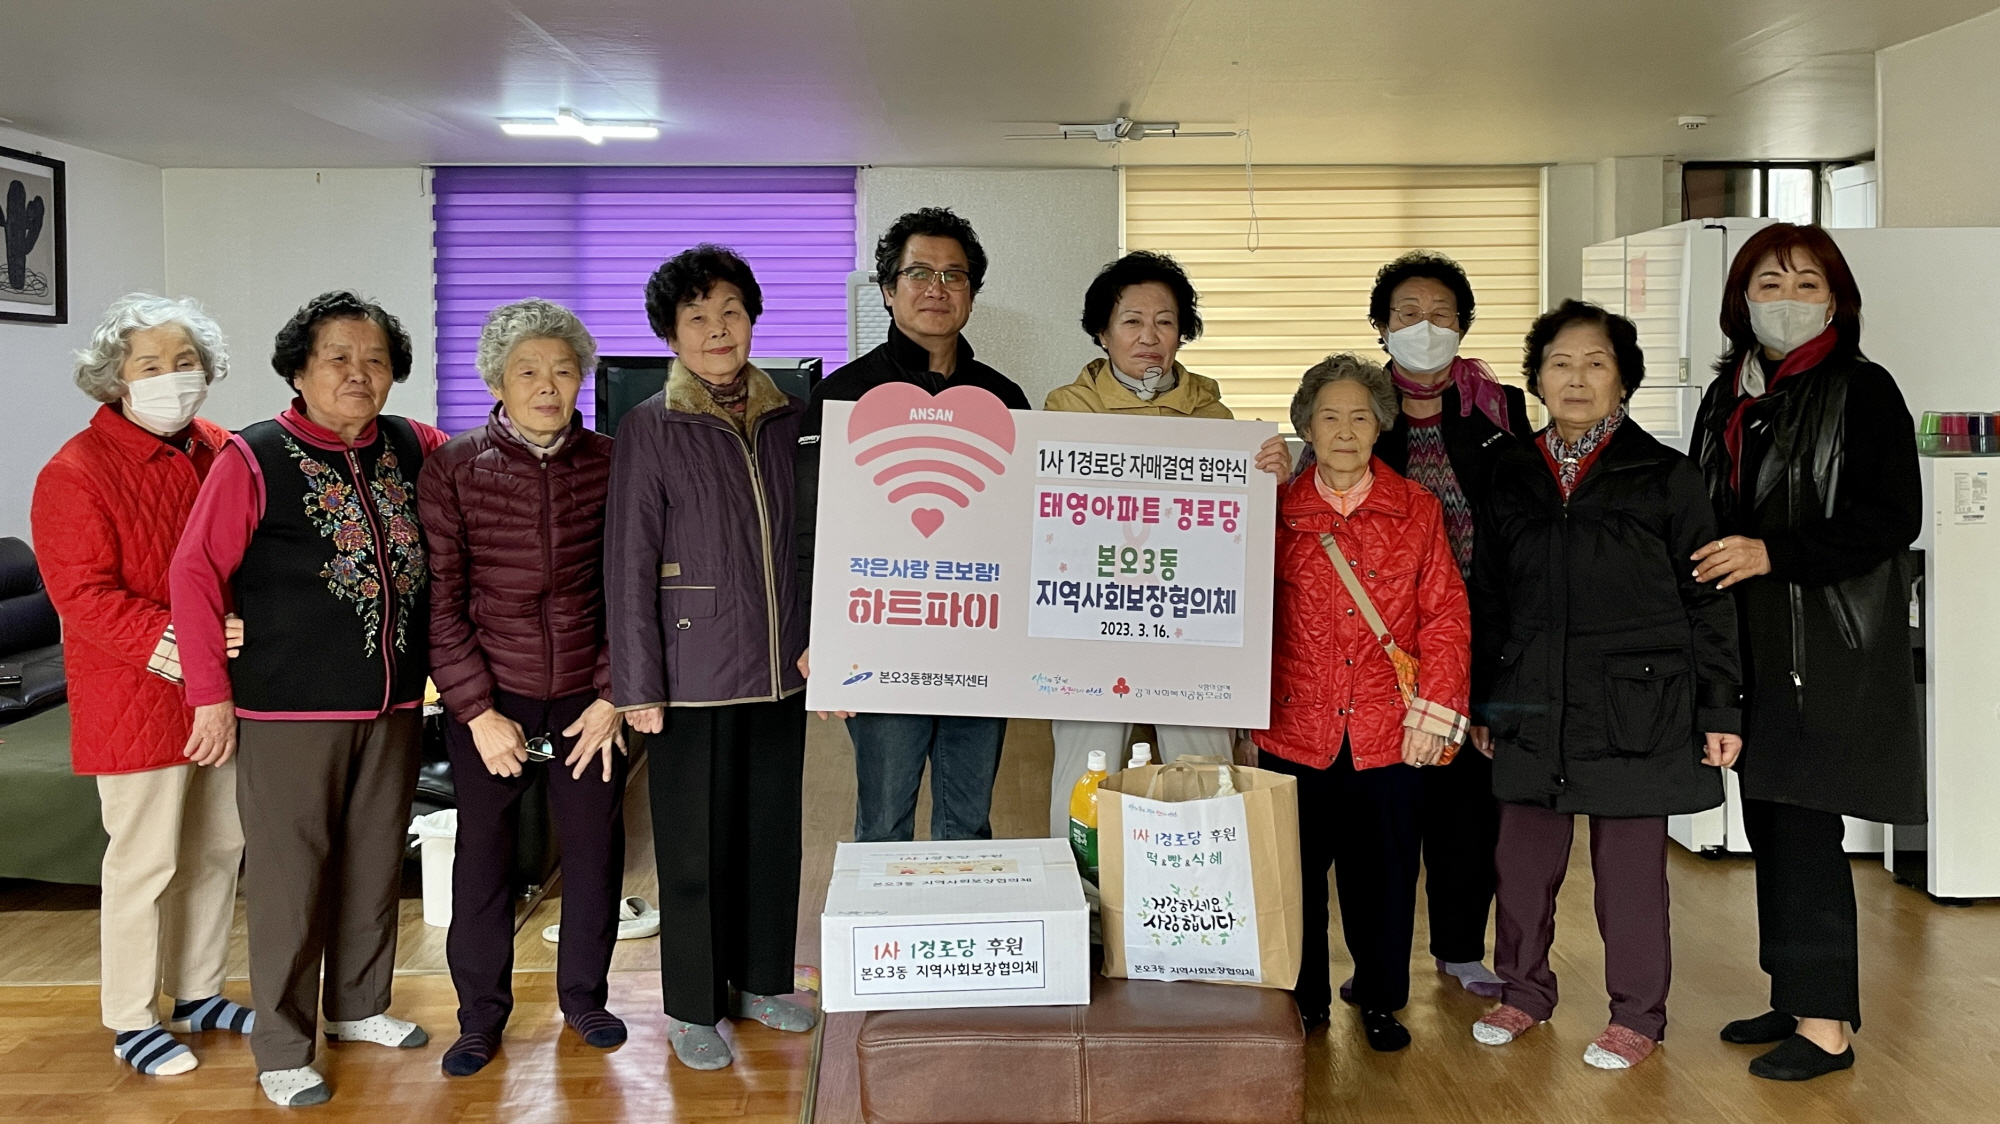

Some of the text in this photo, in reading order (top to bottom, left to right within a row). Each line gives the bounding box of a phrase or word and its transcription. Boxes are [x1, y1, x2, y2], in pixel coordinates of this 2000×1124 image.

[909, 408, 954, 422] ANSAN
[1039, 448, 1247, 485] 1사 1경로당 자매결연 협약식
[1039, 491, 1241, 533] 태영아파트 경로당
[850, 557, 1000, 582] 작은사랑 큰보람!
[1097, 544, 1178, 582] 본오3동
[848, 587, 999, 630] 하트파이
[1036, 580, 1237, 619] 지역사회보장협의체
[1100, 621, 1170, 639] 2023. 3. 16.
[879, 671, 988, 688] 본오3동행정복지센터
[1133, 827, 1237, 847] 1사 1경로당 후원
[1151, 896, 1223, 913] 건강하세요
[1143, 912, 1237, 932] 사랑합니다
[873, 936, 1024, 961] 1사 1경로당 후원
[860, 960, 1039, 981] 본오3동 지역사회보장협의체
[1134, 964, 1255, 977] 본오3동 지역사회보장협의체
